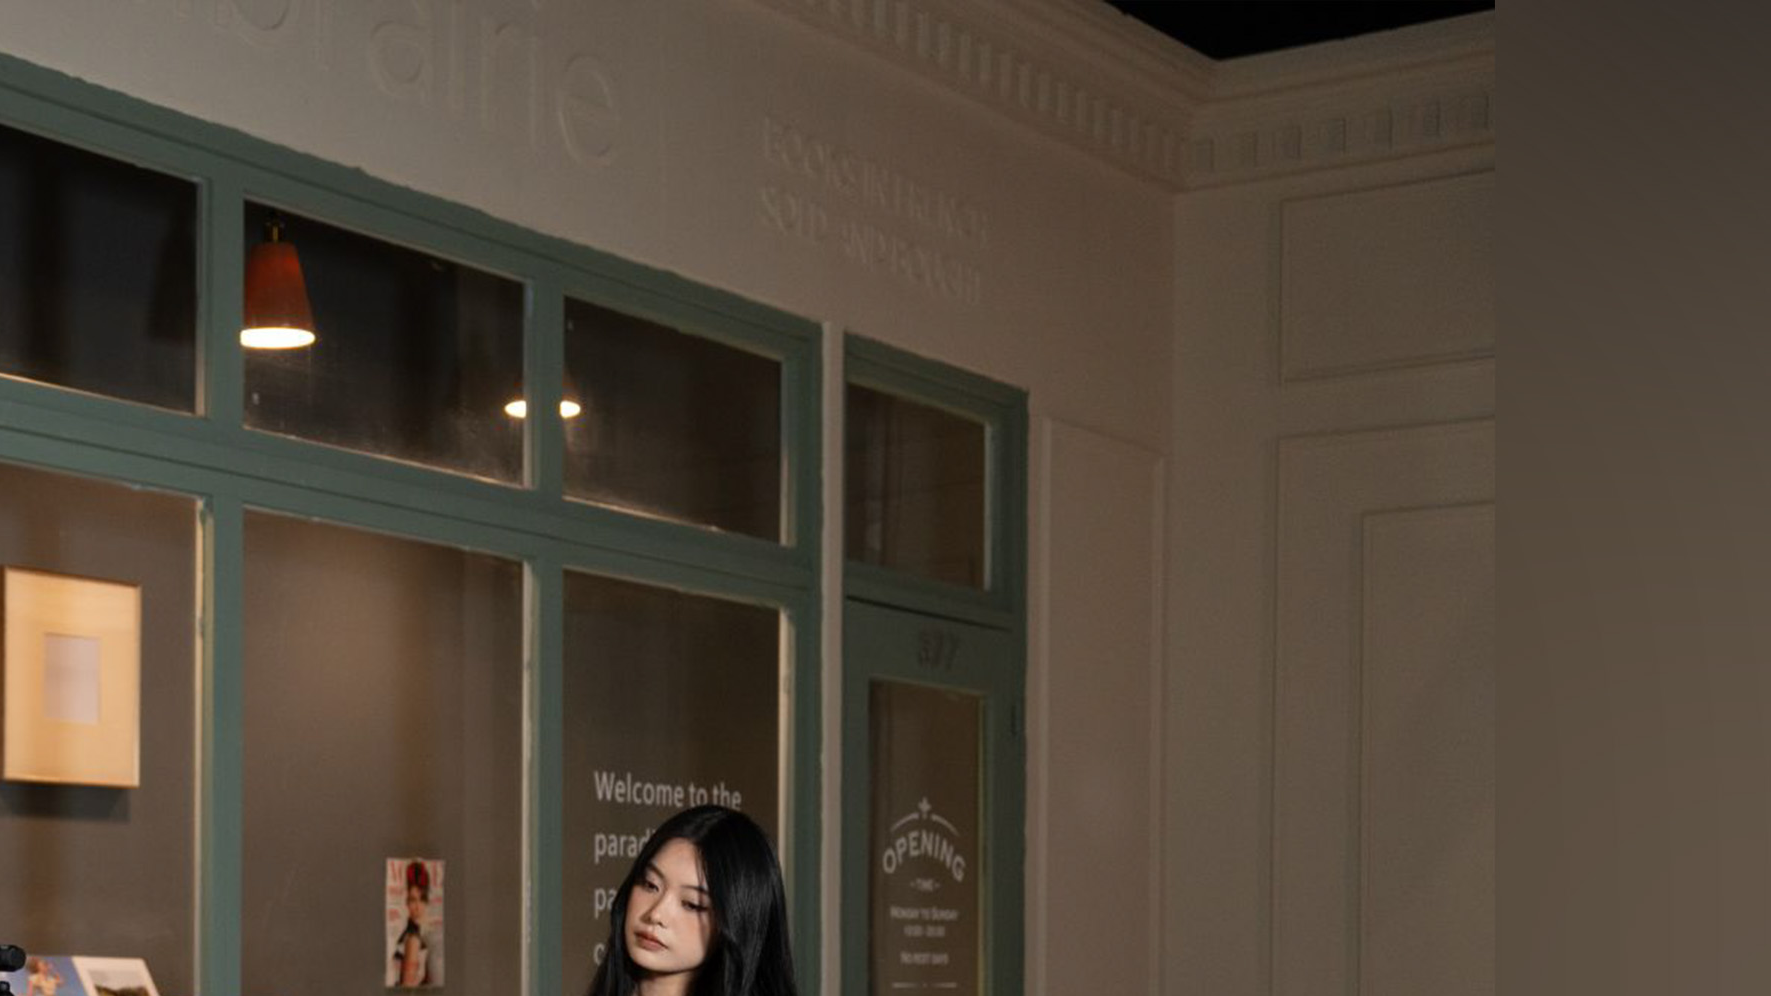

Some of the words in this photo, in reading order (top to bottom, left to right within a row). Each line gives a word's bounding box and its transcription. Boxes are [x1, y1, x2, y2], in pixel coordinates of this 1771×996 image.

[594, 771, 684, 807] Welcome
[688, 783, 708, 808] to
[712, 782, 742, 811] the
[594, 828, 655, 864] parad
[882, 829, 967, 882] OPENING
